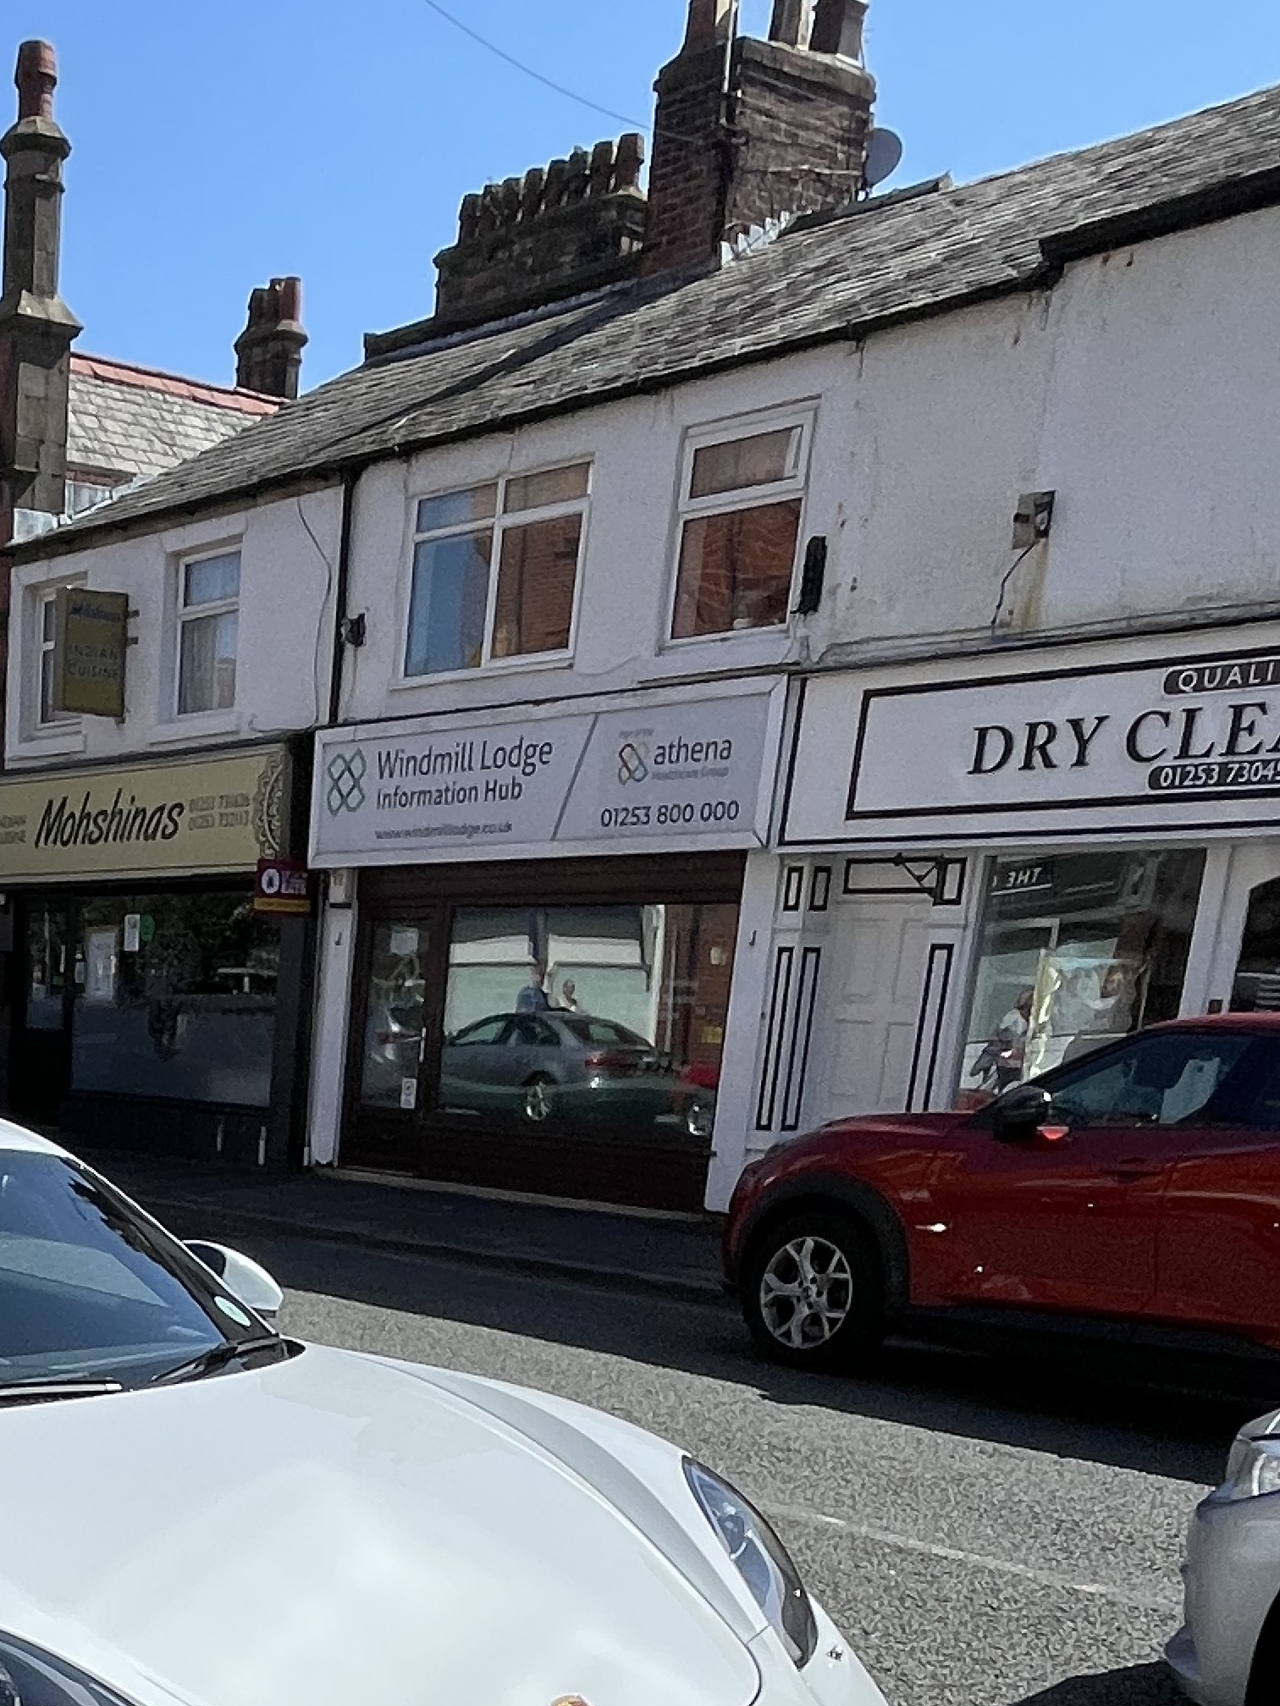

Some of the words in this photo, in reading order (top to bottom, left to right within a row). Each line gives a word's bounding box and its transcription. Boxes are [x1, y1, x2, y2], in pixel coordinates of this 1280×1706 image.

[377, 741, 474, 780] Windmill
[480, 734, 554, 777] Lodge
[653, 735, 733, 766] athena
[967, 714, 1111, 775] DRY
[376, 781, 478, 811] Information
[484, 775, 524, 802] Hub
[1160, 765, 1219, 788] 01253
[34, 787, 186, 850] Mohshinas
[601, 806, 652, 828] 01253
[657, 803, 694, 824] 800
[700, 800, 740, 822] 000
